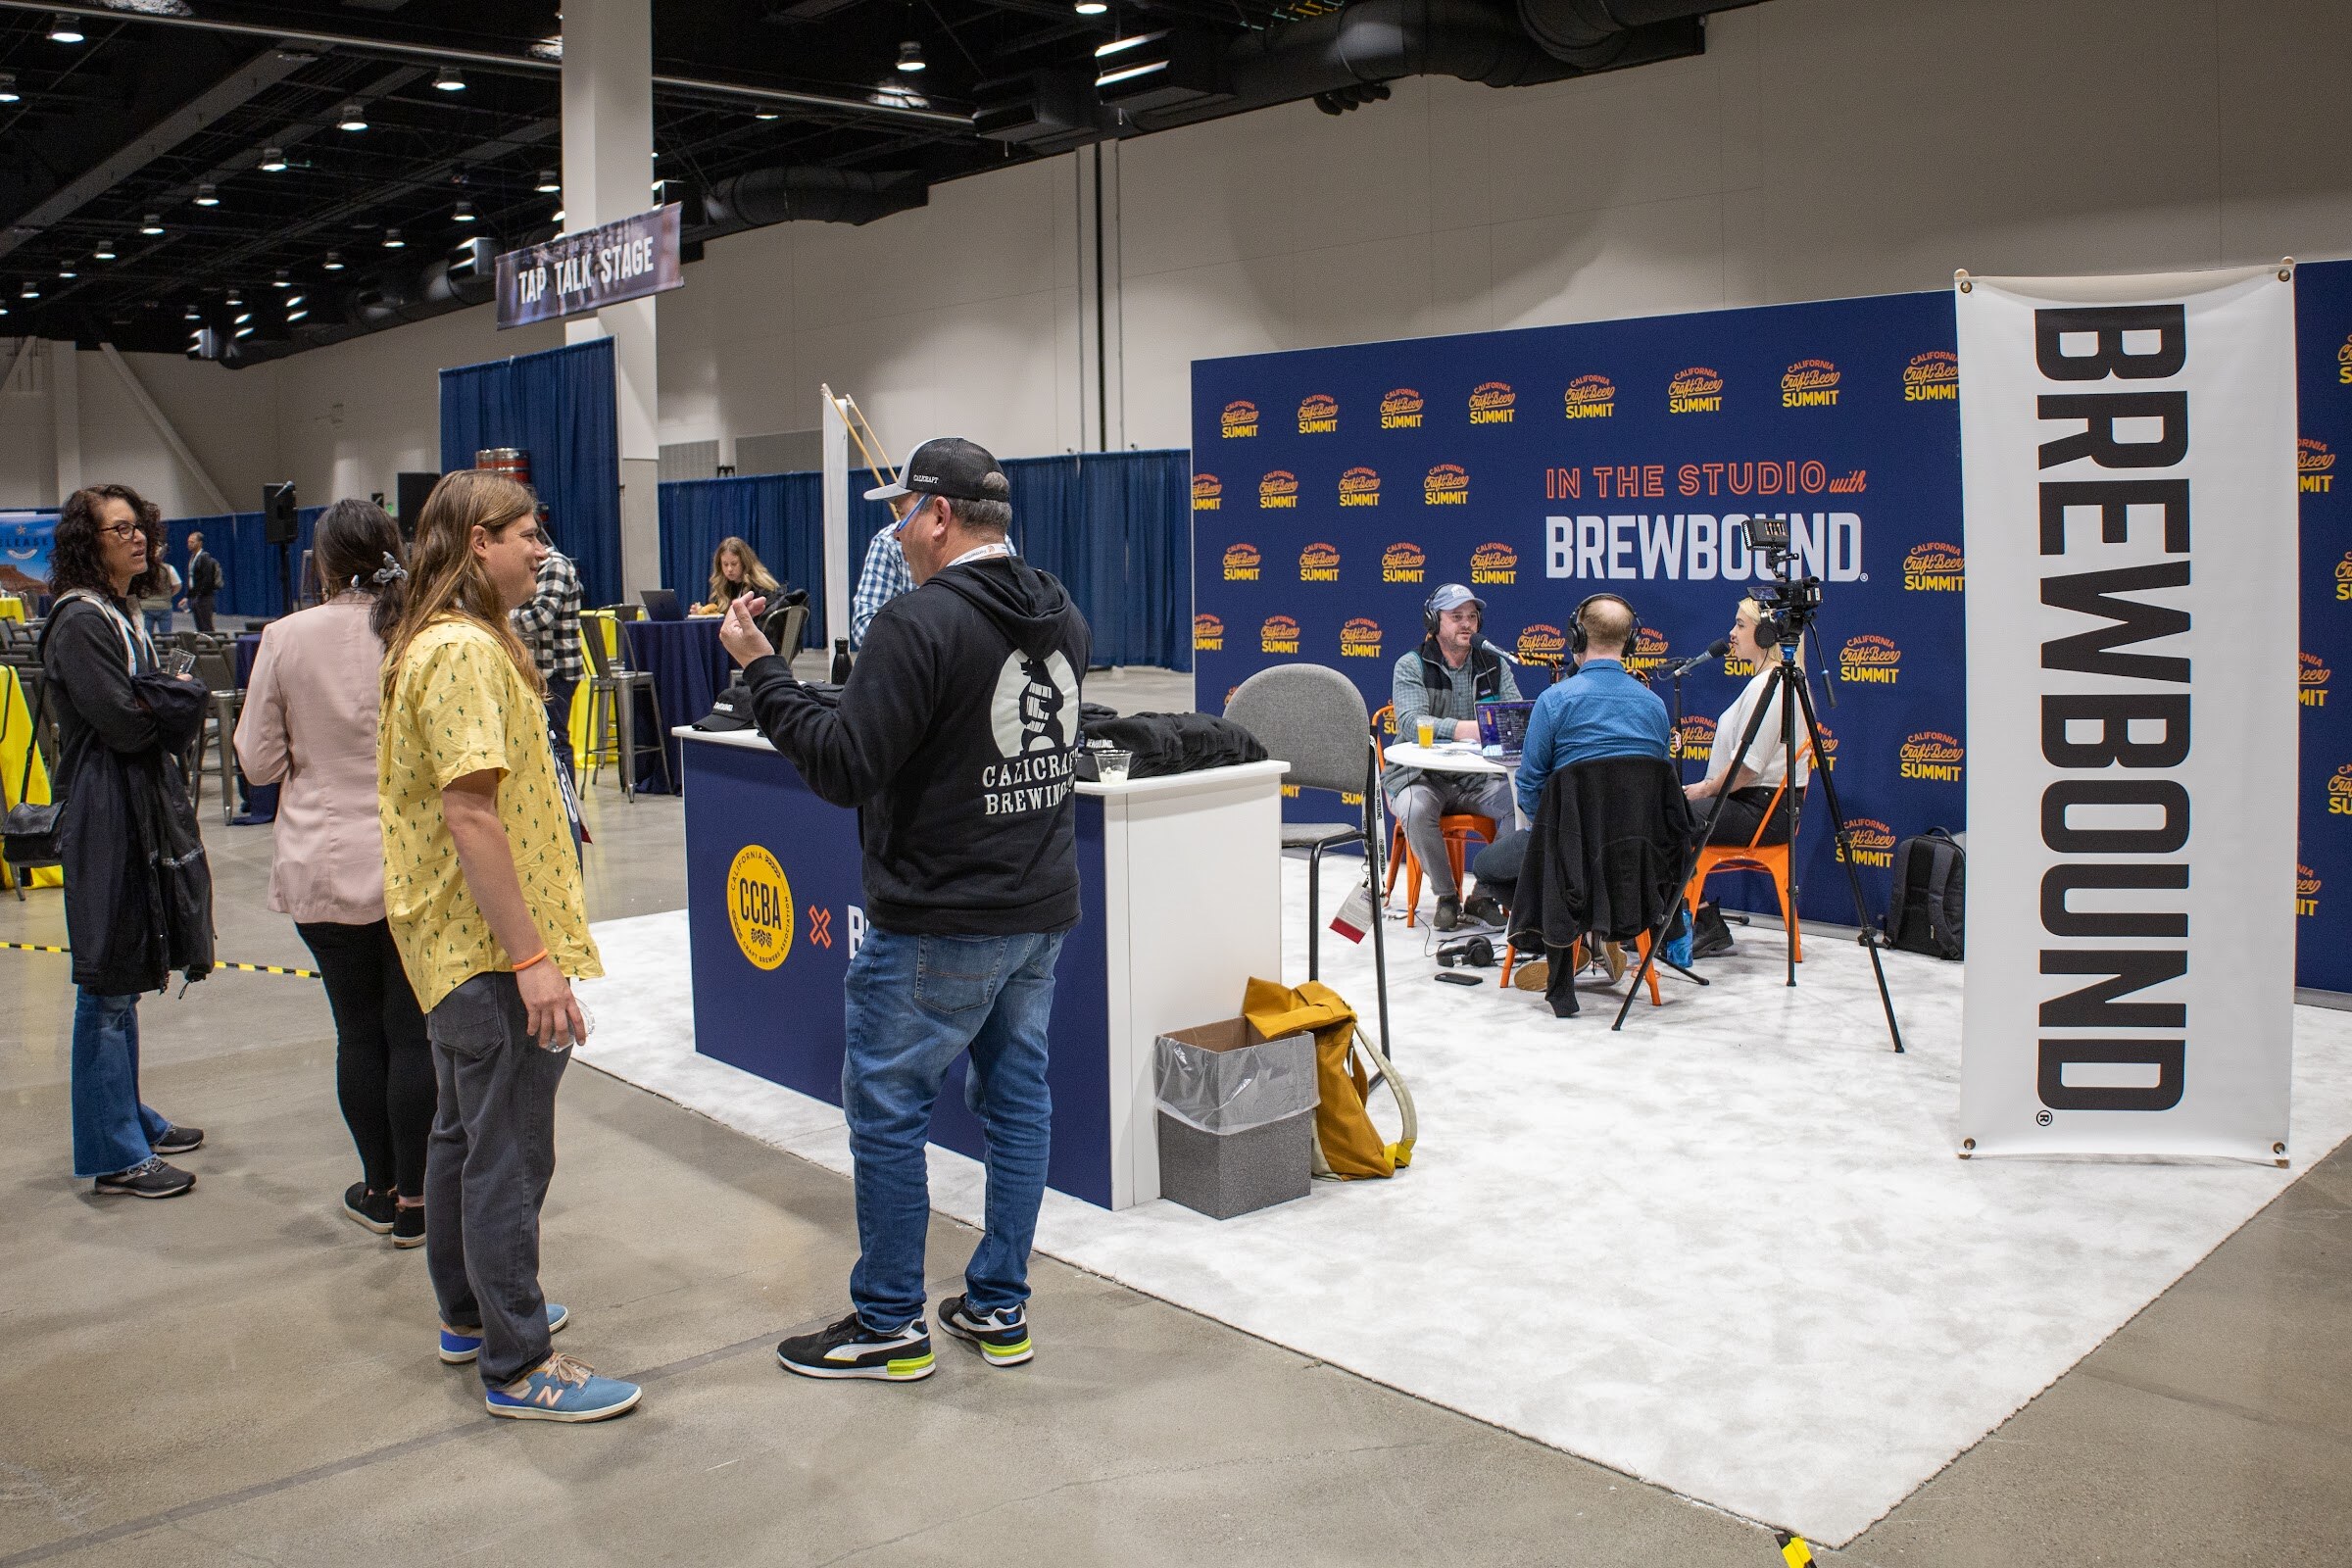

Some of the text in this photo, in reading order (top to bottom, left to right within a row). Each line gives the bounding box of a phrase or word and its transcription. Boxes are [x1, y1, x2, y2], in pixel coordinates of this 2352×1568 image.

[518, 236, 654, 305] TAP TALK STAGE
[1788, 360, 1834, 372] CALIFORNIA
[1935, 362, 1958, 379] Bee
[1675, 368, 1717, 380] CALIFORNIA
[1474, 382, 1510, 393] CALIFORNIA
[1571, 375, 1609, 387] CALIFORNIA
[1386, 389, 1418, 400] CALIFORNIA
[1783, 390, 1838, 407] SUMMIT
[1904, 383, 1959, 401] SUMMI
[1226, 401, 1254, 411] CALIFORNIA
[1302, 395, 1334, 405] CALIFORNIA
[1670, 397, 1722, 413] SUMMIT
[1470, 410, 1514, 423] SUMMIT
[1566, 404, 1614, 418] SUMMIT
[1298, 419, 1337, 433] SUMMIT
[1382, 415, 1422, 428] SUMMIT
[1222, 425, 1257, 438] SUMMIT
[1264, 471, 1294, 480] CALIFORNIA
[1344, 467, 1376, 477] CALIFORNIA
[1430, 465, 1464, 474] CALIFORNIA
[1546, 460, 1867, 499] IN THE STUDIO with
[2299, 474, 2334, 492] MIT
[1193, 498, 1221, 510] UMMIT
[1260, 496, 1297, 508] SUMMIT
[1340, 494, 1379, 506] SUMMIT
[1425, 492, 1468, 505] SUMMIT
[1228, 544, 1256, 554] CALIFORNIA
[1304, 543, 1335, 553] CALIFORNIA
[1387, 543, 1420, 554] CALIFORNIA
[1476, 543, 1512, 554] CALIFORNIA
[1910, 542, 1961, 556] CALIFORNIA
[1224, 569, 1259, 580] SUMMIT
[1300, 569, 1339, 580] SUMMIT
[1383, 570, 1424, 582] SUMMIT
[1472, 571, 1516, 584] SUMMIT
[1904, 574, 1965, 592] SUMMIT
[1266, 616, 1296, 626] CALIFORNIA
[1346, 618, 1377, 629] CALIFORNIA
[1522, 623, 1561, 637] CALIFORNIA
[1641, 628, 1663, 641] ORNIA
[1194, 638, 1223, 651] UMMIT
[1262, 641, 1298, 653] SUMMIT
[1847, 636, 1894, 649] CALIFORNIA
[1342, 645, 1381, 657] SUMMIT
[1724, 662, 1755, 676] SUM
[1840, 667, 1899, 683] SUMMIT
[2299, 666, 2330, 683] eer
[2299, 689, 2328, 706] MIT
[2034, 304, 2191, 1110] BREWBOUND
[1680, 716, 1717, 730] ALIFORNIA
[1693, 726, 1714, 741] Bee
[1908, 732, 1957, 747] CALIFORNIA
[1901, 763, 1961, 781] SUMMIT
[1342, 792, 1363, 805] SUM
[1843, 818, 1890, 834] CALIFORNIA
[731, 851, 762, 891] CALIFORNIA
[740, 878, 782, 930] CCBA
[534, 1385, 564, 1407] N
